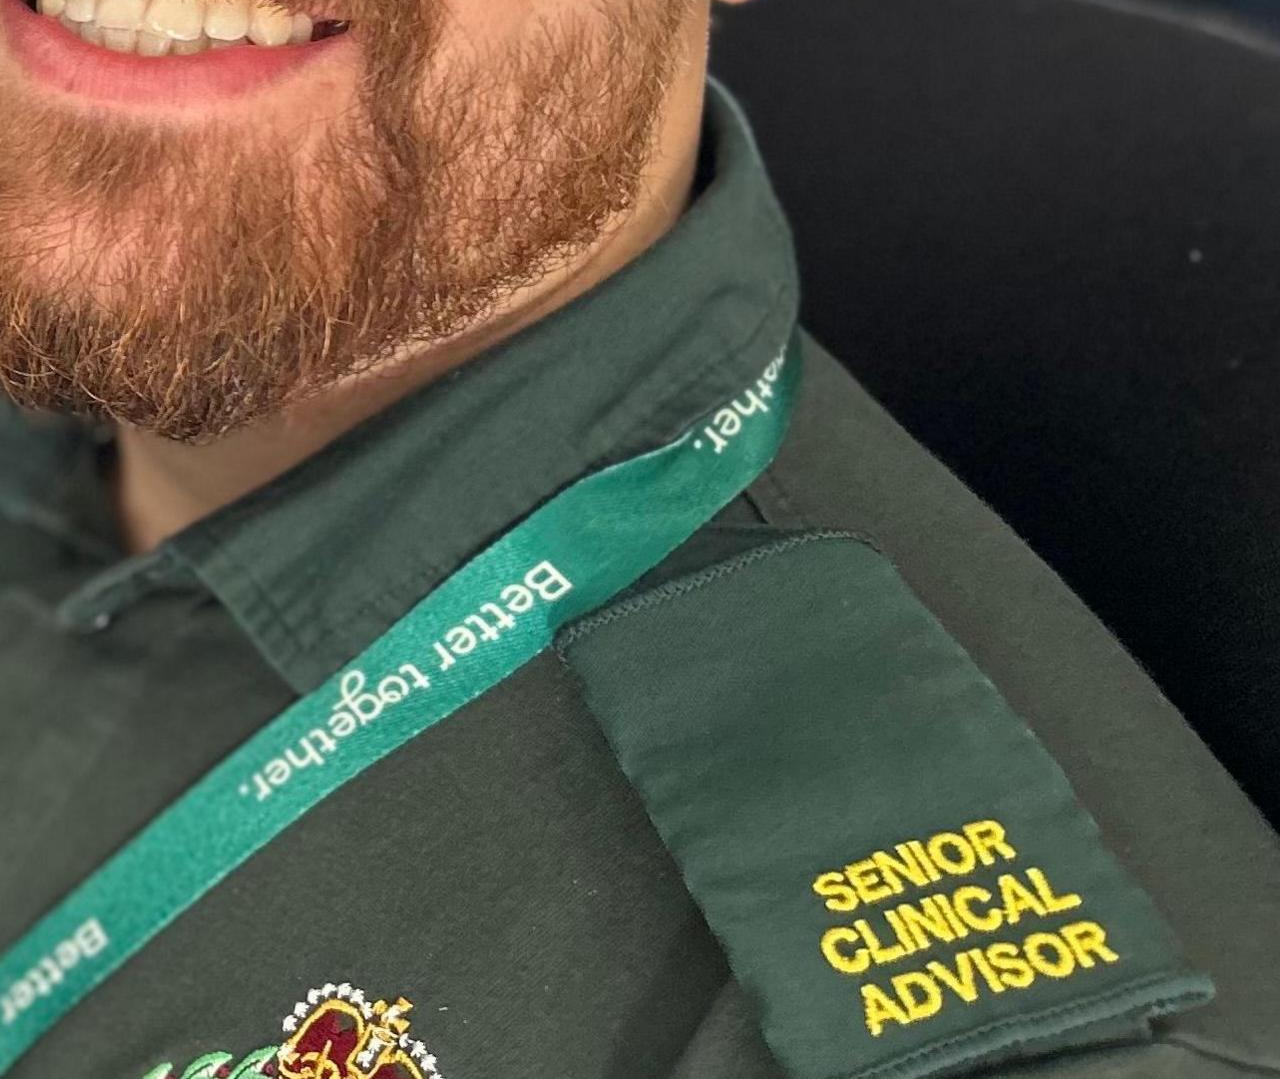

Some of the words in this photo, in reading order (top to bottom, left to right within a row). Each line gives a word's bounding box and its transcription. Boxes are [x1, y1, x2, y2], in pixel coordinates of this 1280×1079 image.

[432, 560, 573, 672] Better
[238, 663, 431, 802] together.
[812, 819, 1017, 912] SENIOR
[819, 867, 1082, 974] CLINICAL
[0, 917, 109, 1025] Better
[859, 920, 1120, 1037] ADVISOR
